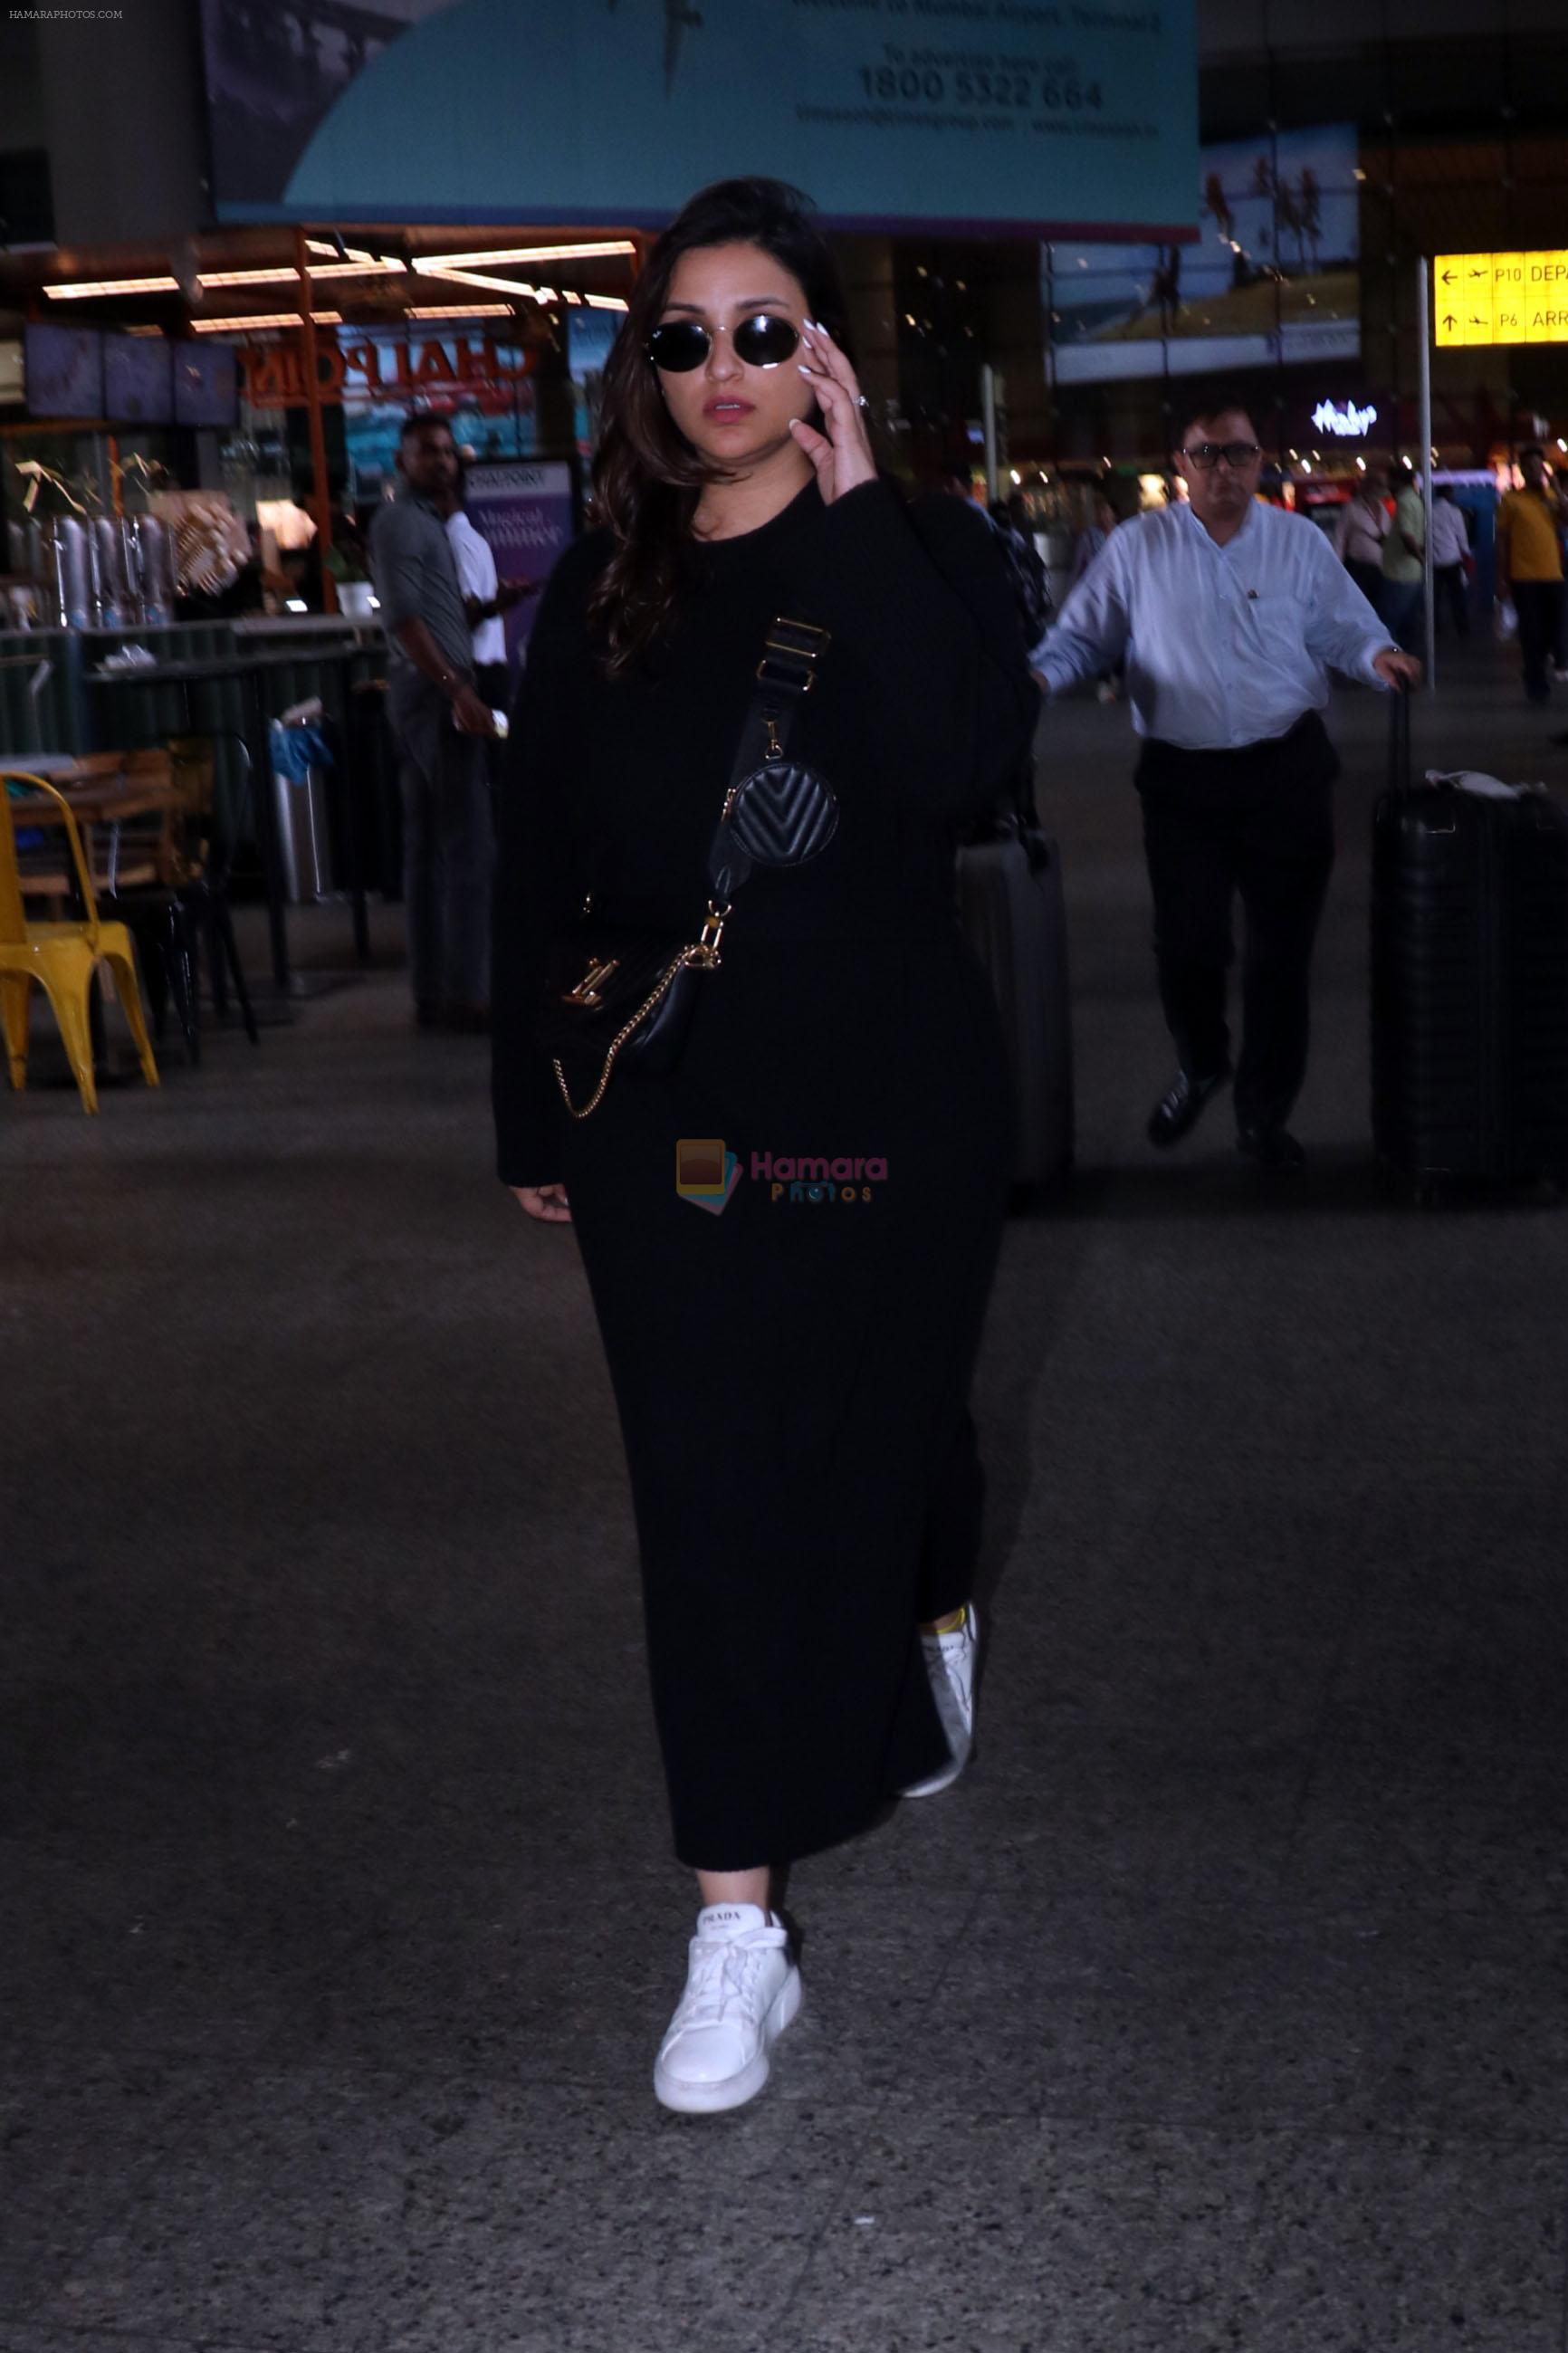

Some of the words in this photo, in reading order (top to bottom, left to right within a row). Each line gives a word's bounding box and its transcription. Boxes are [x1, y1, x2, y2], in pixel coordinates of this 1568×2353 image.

[857, 64, 944, 102] 1800
[955, 70, 1031, 108] 5322
[1043, 76, 1104, 111] 664
[1495, 268, 1522, 282] P10
[1531, 264, 1568, 282] DEP
[1500, 314, 1518, 327] P6
[703, 1910, 741, 1925] PRADA
